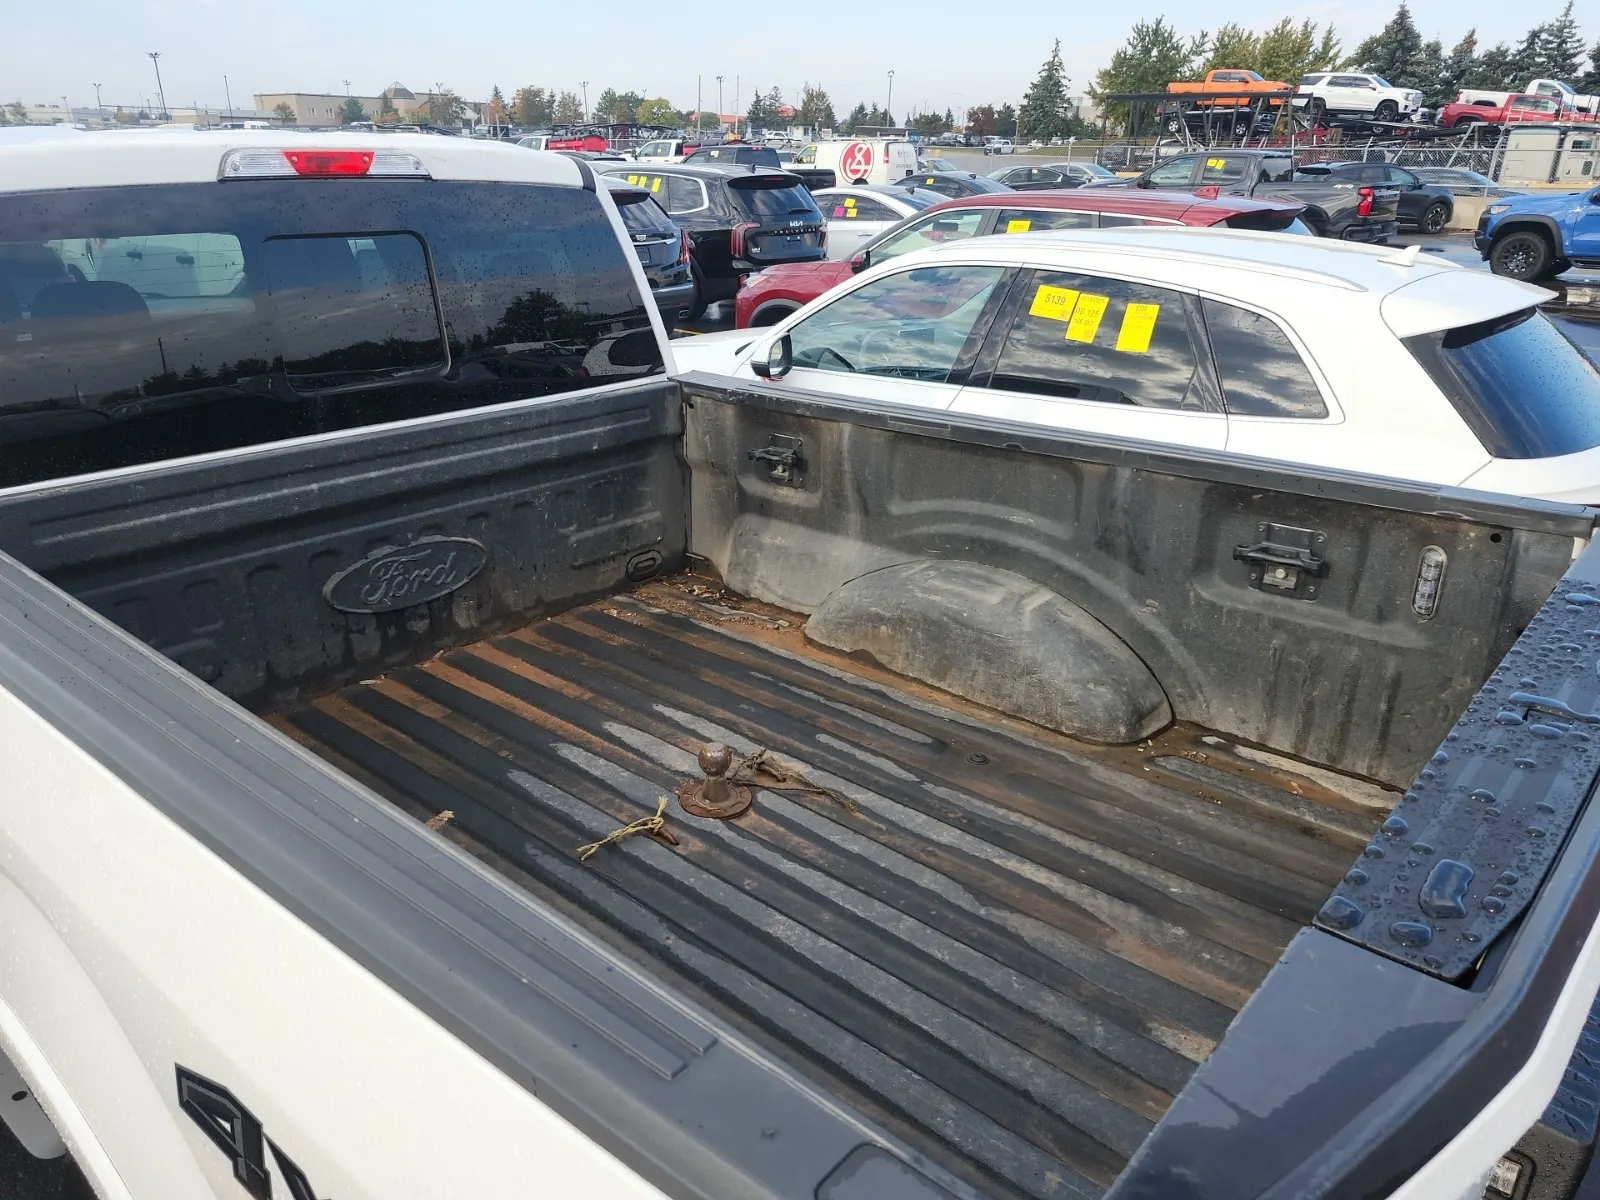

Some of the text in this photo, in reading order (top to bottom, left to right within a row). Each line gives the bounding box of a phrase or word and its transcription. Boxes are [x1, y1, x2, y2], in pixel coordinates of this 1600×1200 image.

[1044, 293, 1067, 306] 5139
[1087, 308, 1100, 318] 125
[361, 548, 457, 605] Ford
